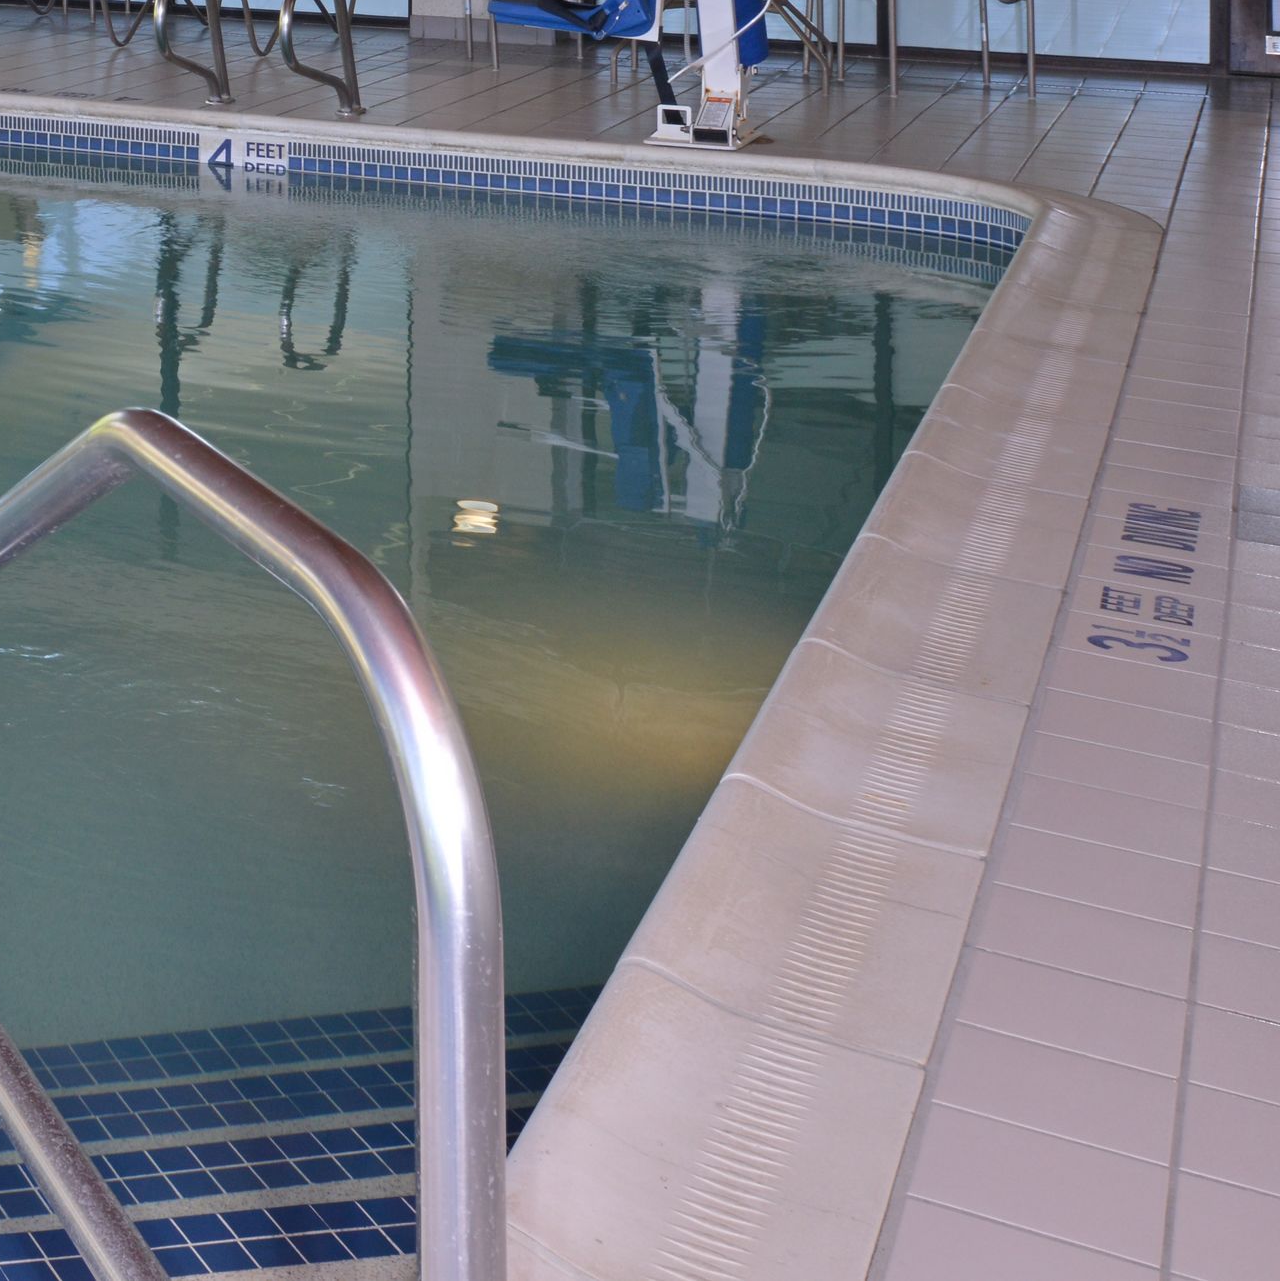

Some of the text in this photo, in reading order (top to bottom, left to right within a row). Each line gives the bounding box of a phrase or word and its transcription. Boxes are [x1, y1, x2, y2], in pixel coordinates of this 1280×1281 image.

[208, 138, 286, 167] 4 FEET
[1113, 503, 1202, 585] NO DIVING
[1100, 586, 1142, 615] FEET
[1153, 595, 1194, 626] DEEP
